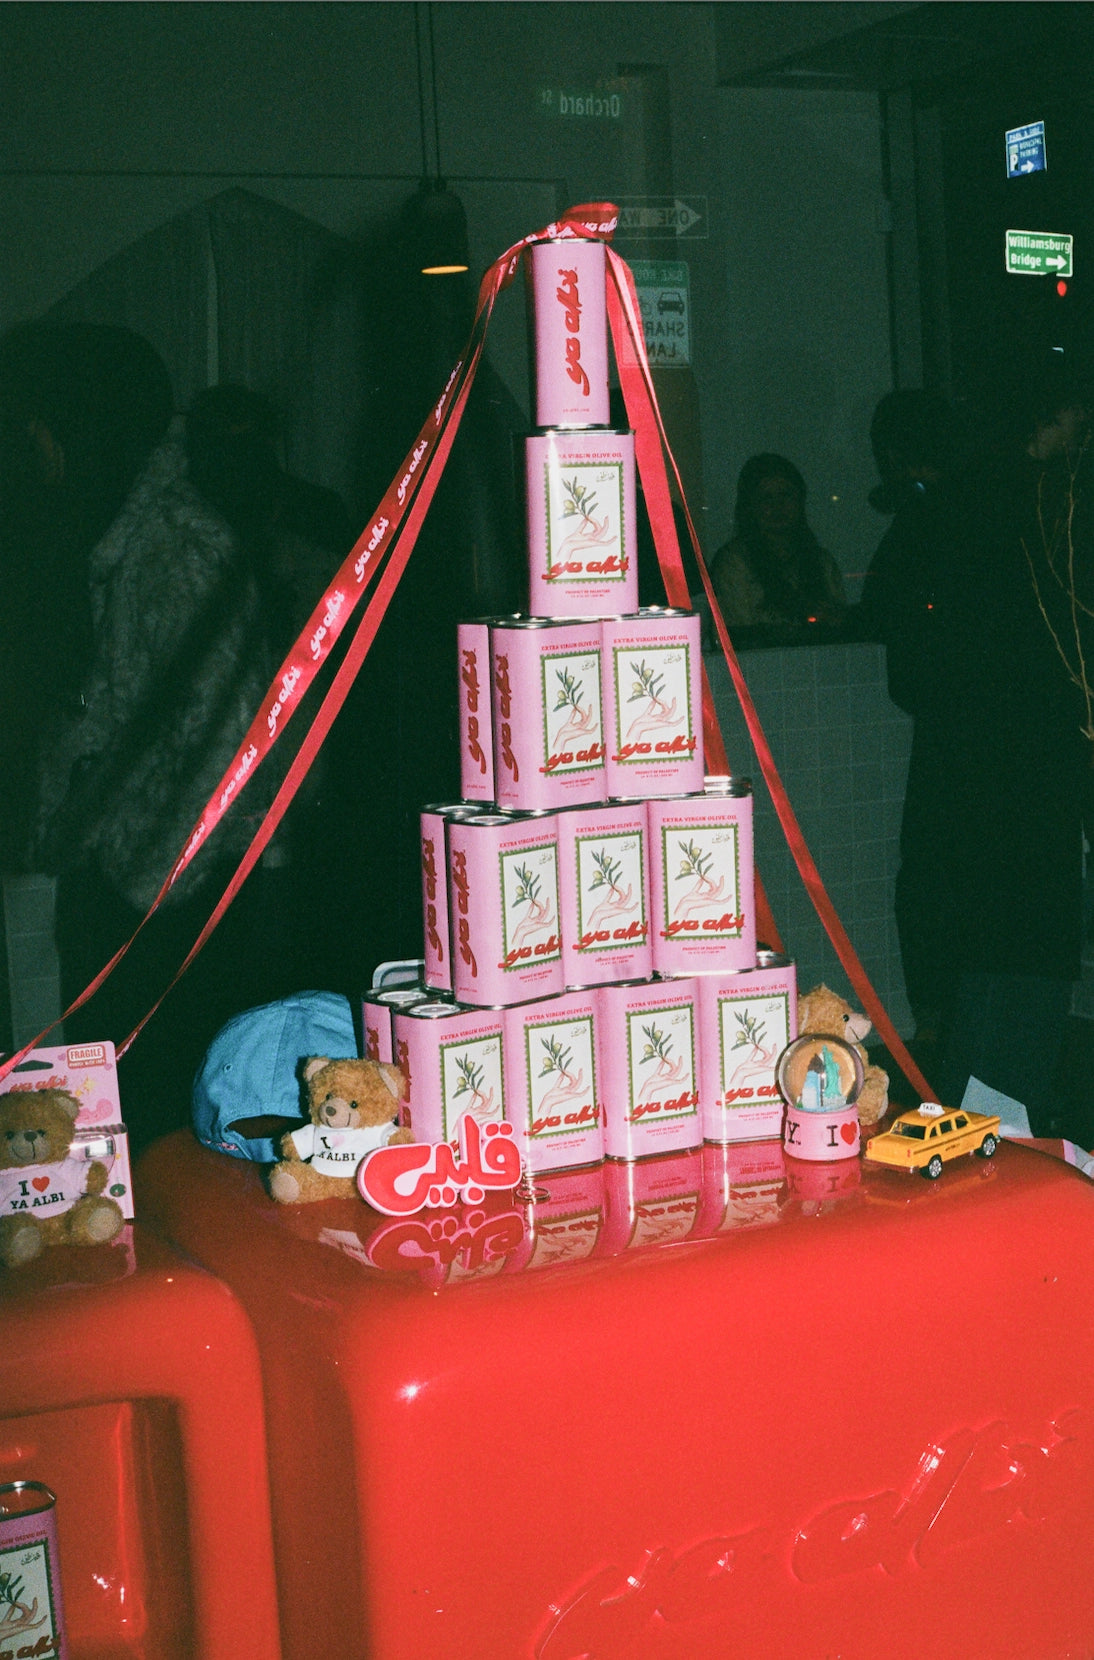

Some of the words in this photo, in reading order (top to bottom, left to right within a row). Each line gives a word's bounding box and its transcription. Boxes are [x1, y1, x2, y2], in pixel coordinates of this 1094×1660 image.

[1010, 154, 1019, 172] P
[1008, 236, 1070, 254] Williamsburg
[1010, 253, 1042, 269] Bridge
[499, 840, 517, 848] EXTRA
[518, 837, 535, 845] VIRGIN
[627, 1001, 647, 1009] EXTRA
[648, 998, 667, 1006] VIRGIN
[525, 1013, 545, 1022] EXTRA
[546, 1010, 565, 1018] VIRGIN
[440, 1032, 459, 1041] EXTRA
[460, 1029, 478, 1037] VIRGIN
[478, 1025, 493, 1033] OLIVE
[70, 1047, 102, 1060] FRAGILE
[320, 1136, 331, 1149] I
[826, 1124, 839, 1147] I
[364, 1115, 521, 1211] قلبي
[18, 1180, 30, 1196] I
[10, 1199, 29, 1210] YA
[32, 1192, 65, 1207] ALBI
